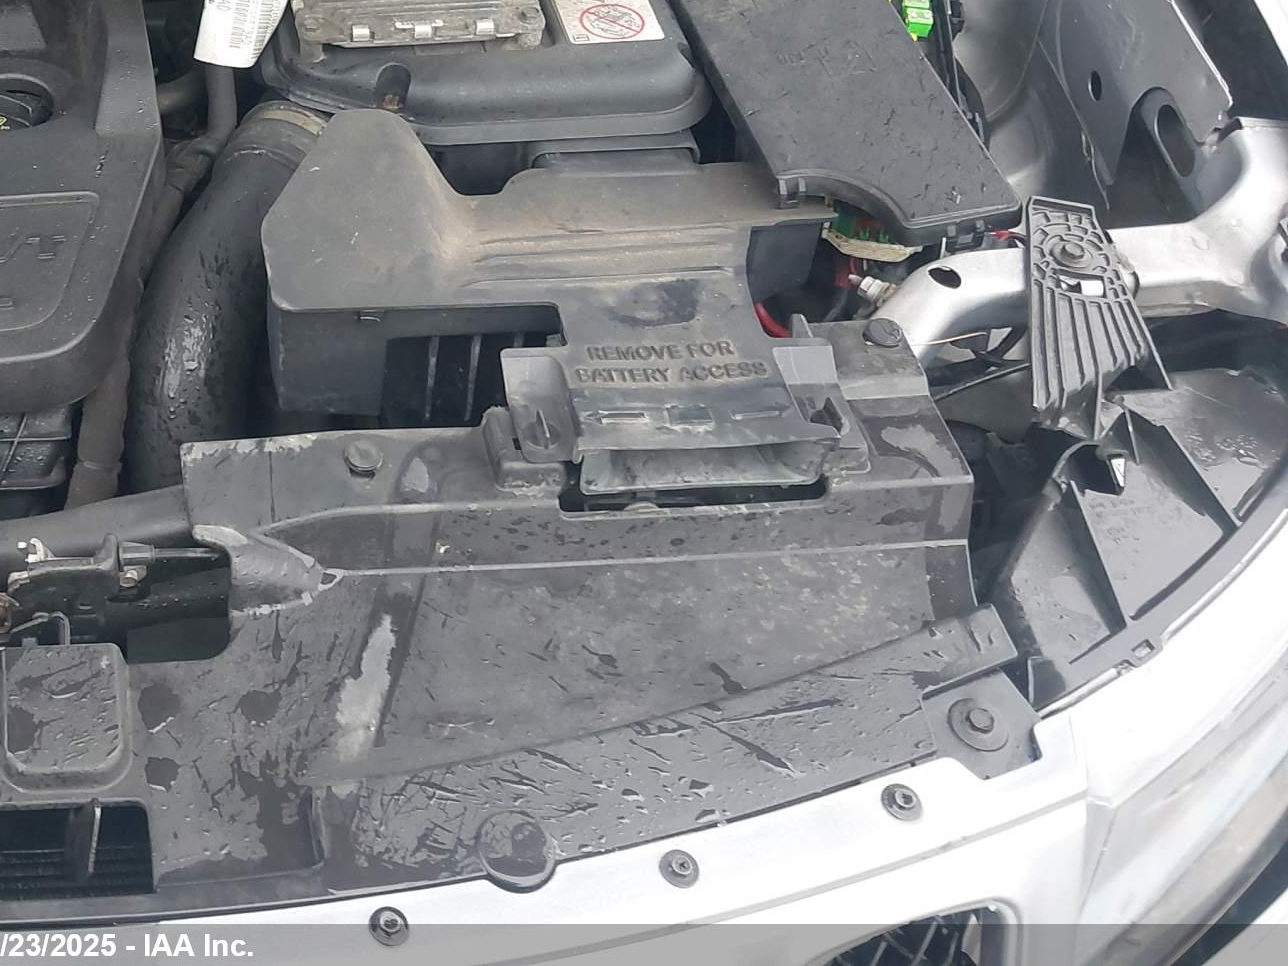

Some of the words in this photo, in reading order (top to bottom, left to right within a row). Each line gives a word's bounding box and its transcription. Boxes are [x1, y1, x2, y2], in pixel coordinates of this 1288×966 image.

[586, 343, 682, 362] REMOVE
[685, 339, 735, 359] FOR
[575, 367, 669, 384] BATTERY
[679, 361, 768, 382] ACCESS
